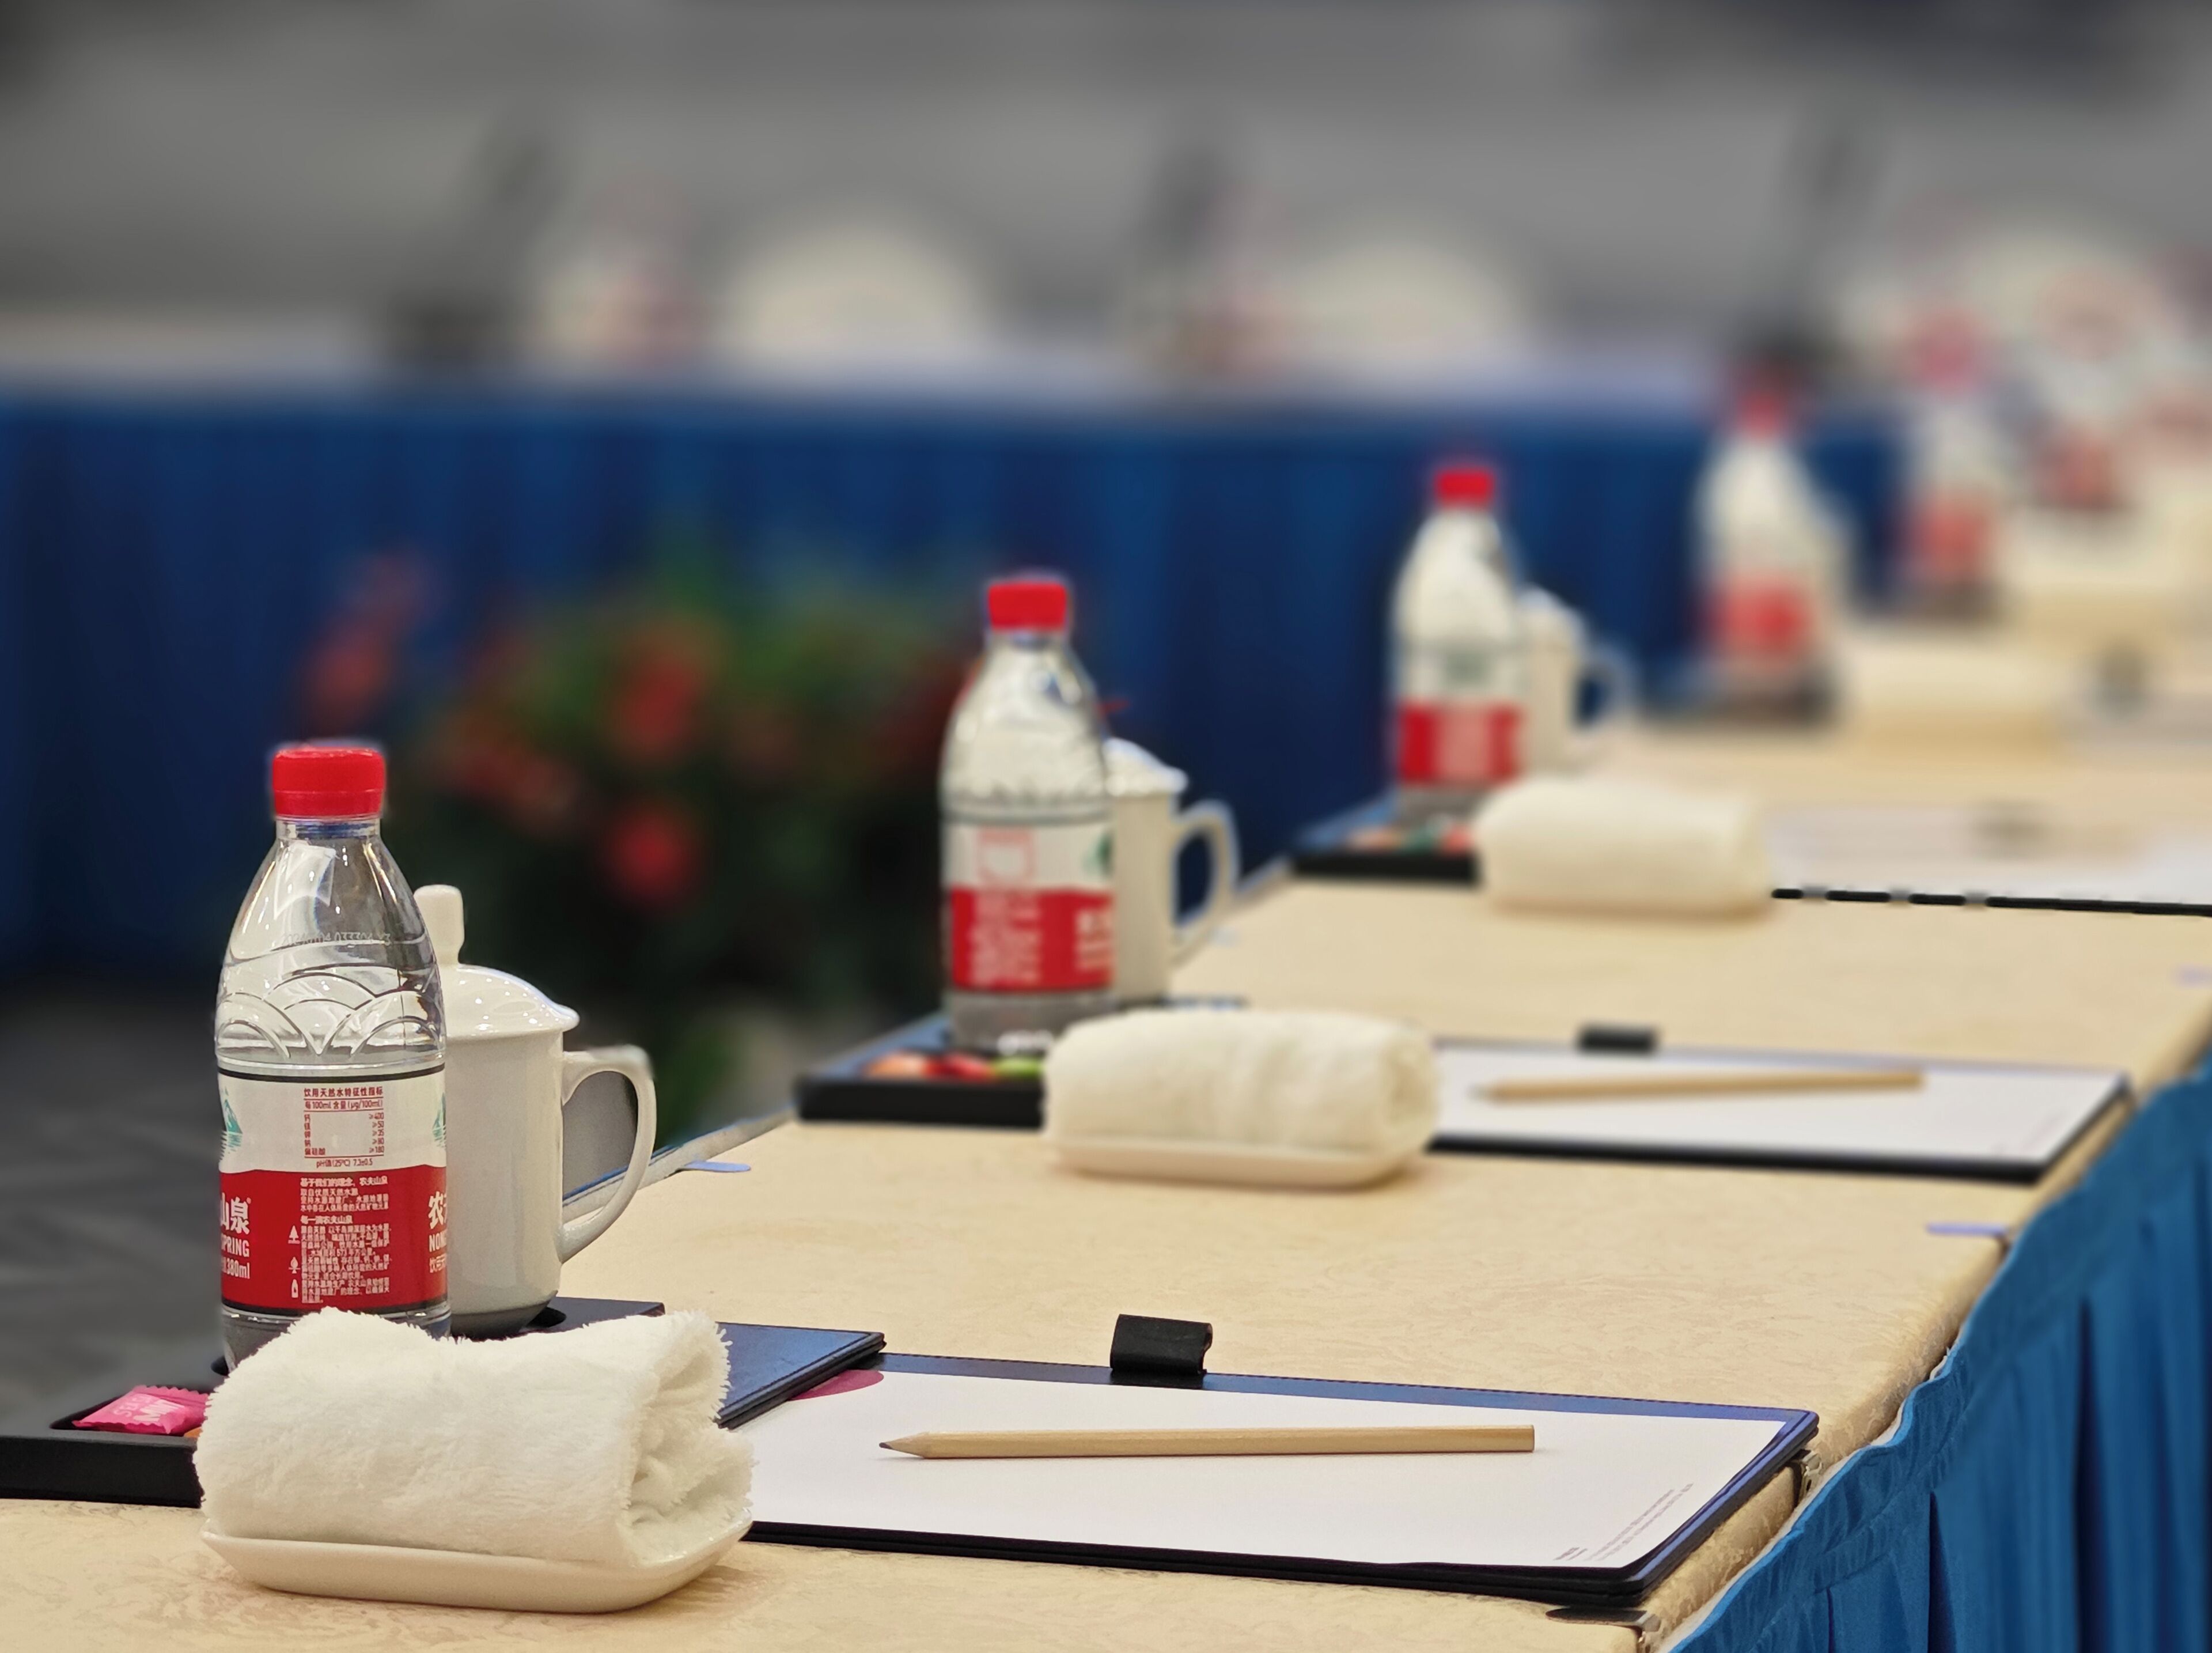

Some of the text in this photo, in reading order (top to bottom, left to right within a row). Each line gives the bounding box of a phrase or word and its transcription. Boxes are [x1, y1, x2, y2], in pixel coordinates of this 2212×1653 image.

[304, 1087, 383, 1097] 饮用天然水特征性指标
